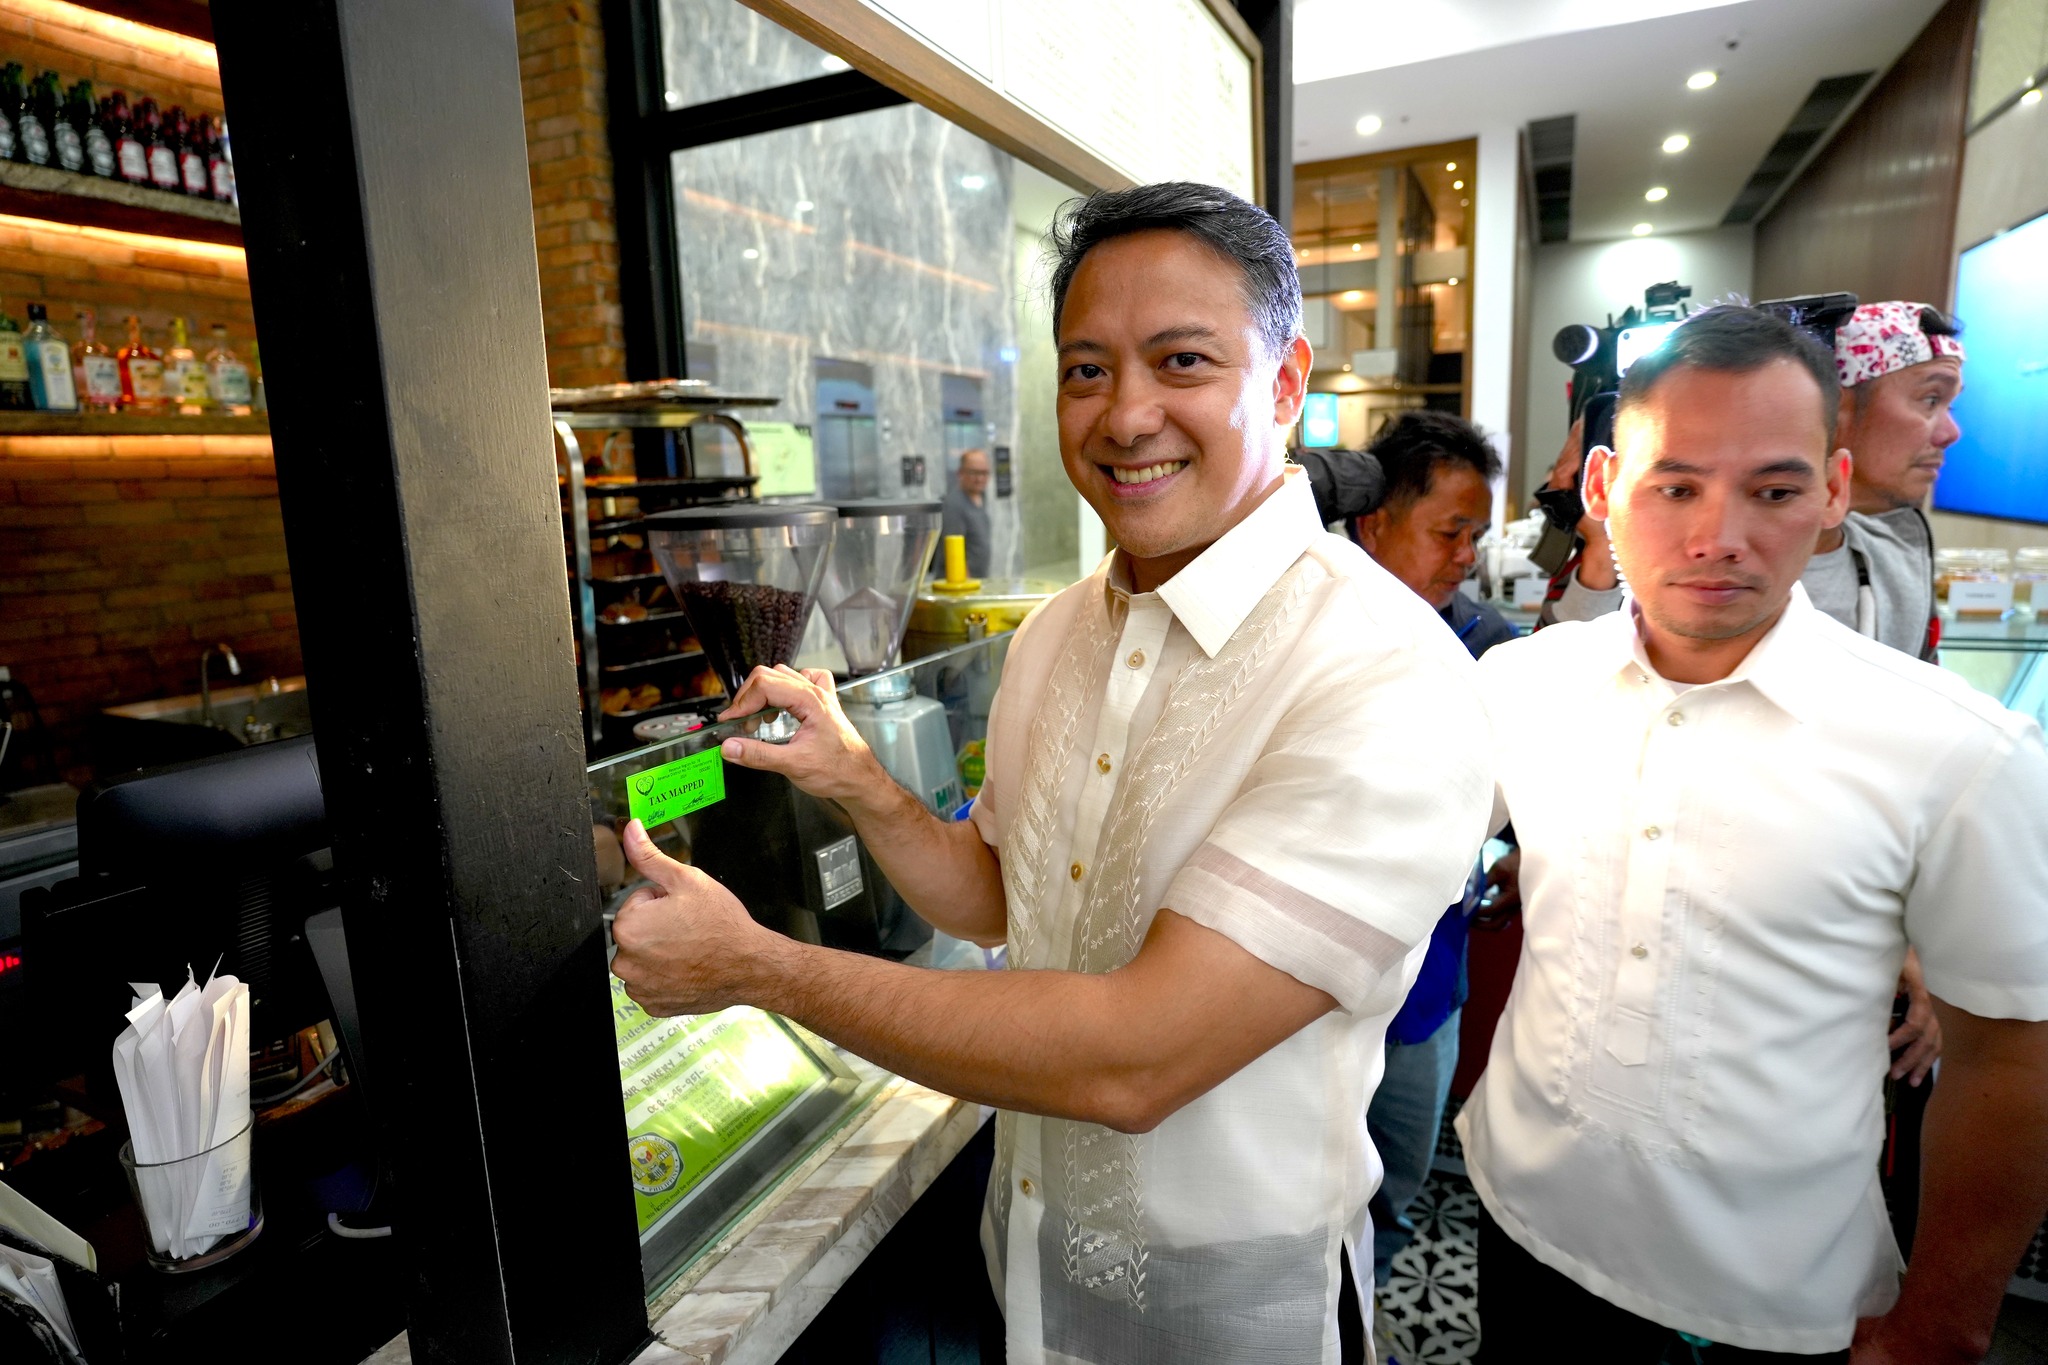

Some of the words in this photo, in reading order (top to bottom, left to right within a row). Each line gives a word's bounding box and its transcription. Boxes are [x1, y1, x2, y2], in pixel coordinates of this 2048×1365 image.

[649, 793, 667, 806] TAX
[669, 779, 704, 799] MAPPED
[616, 1017, 658, 1046] endere
[621, 1041, 655, 1067] BAKERY
[622, 1085, 640, 1100] OUR
[641, 1059, 675, 1086] BAKERY
[648, 1166, 678, 1191] PHILIPPINES
